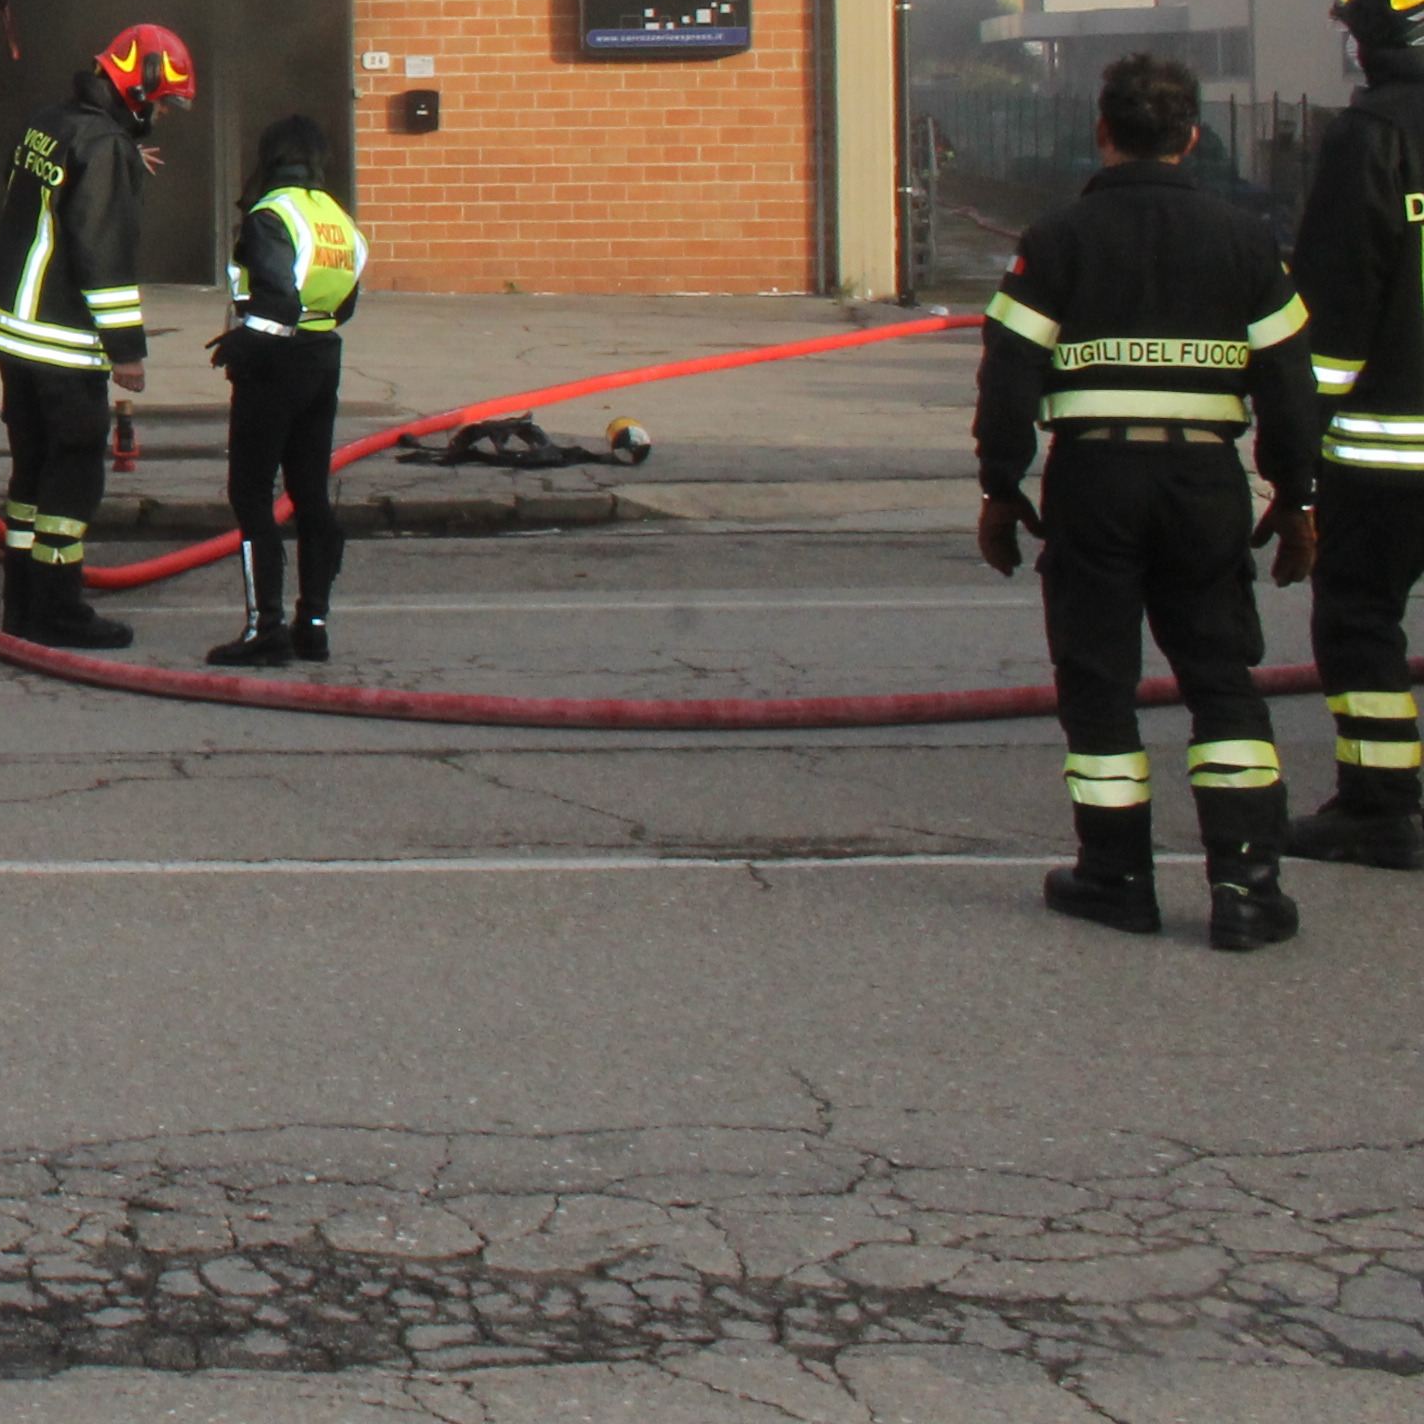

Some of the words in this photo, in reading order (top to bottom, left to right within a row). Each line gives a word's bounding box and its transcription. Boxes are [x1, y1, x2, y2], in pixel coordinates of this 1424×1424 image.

[1059, 341, 1121, 367] VIGILI
[1129, 342, 1172, 364] DEL
[1180, 343, 1247, 365] FUOCO
